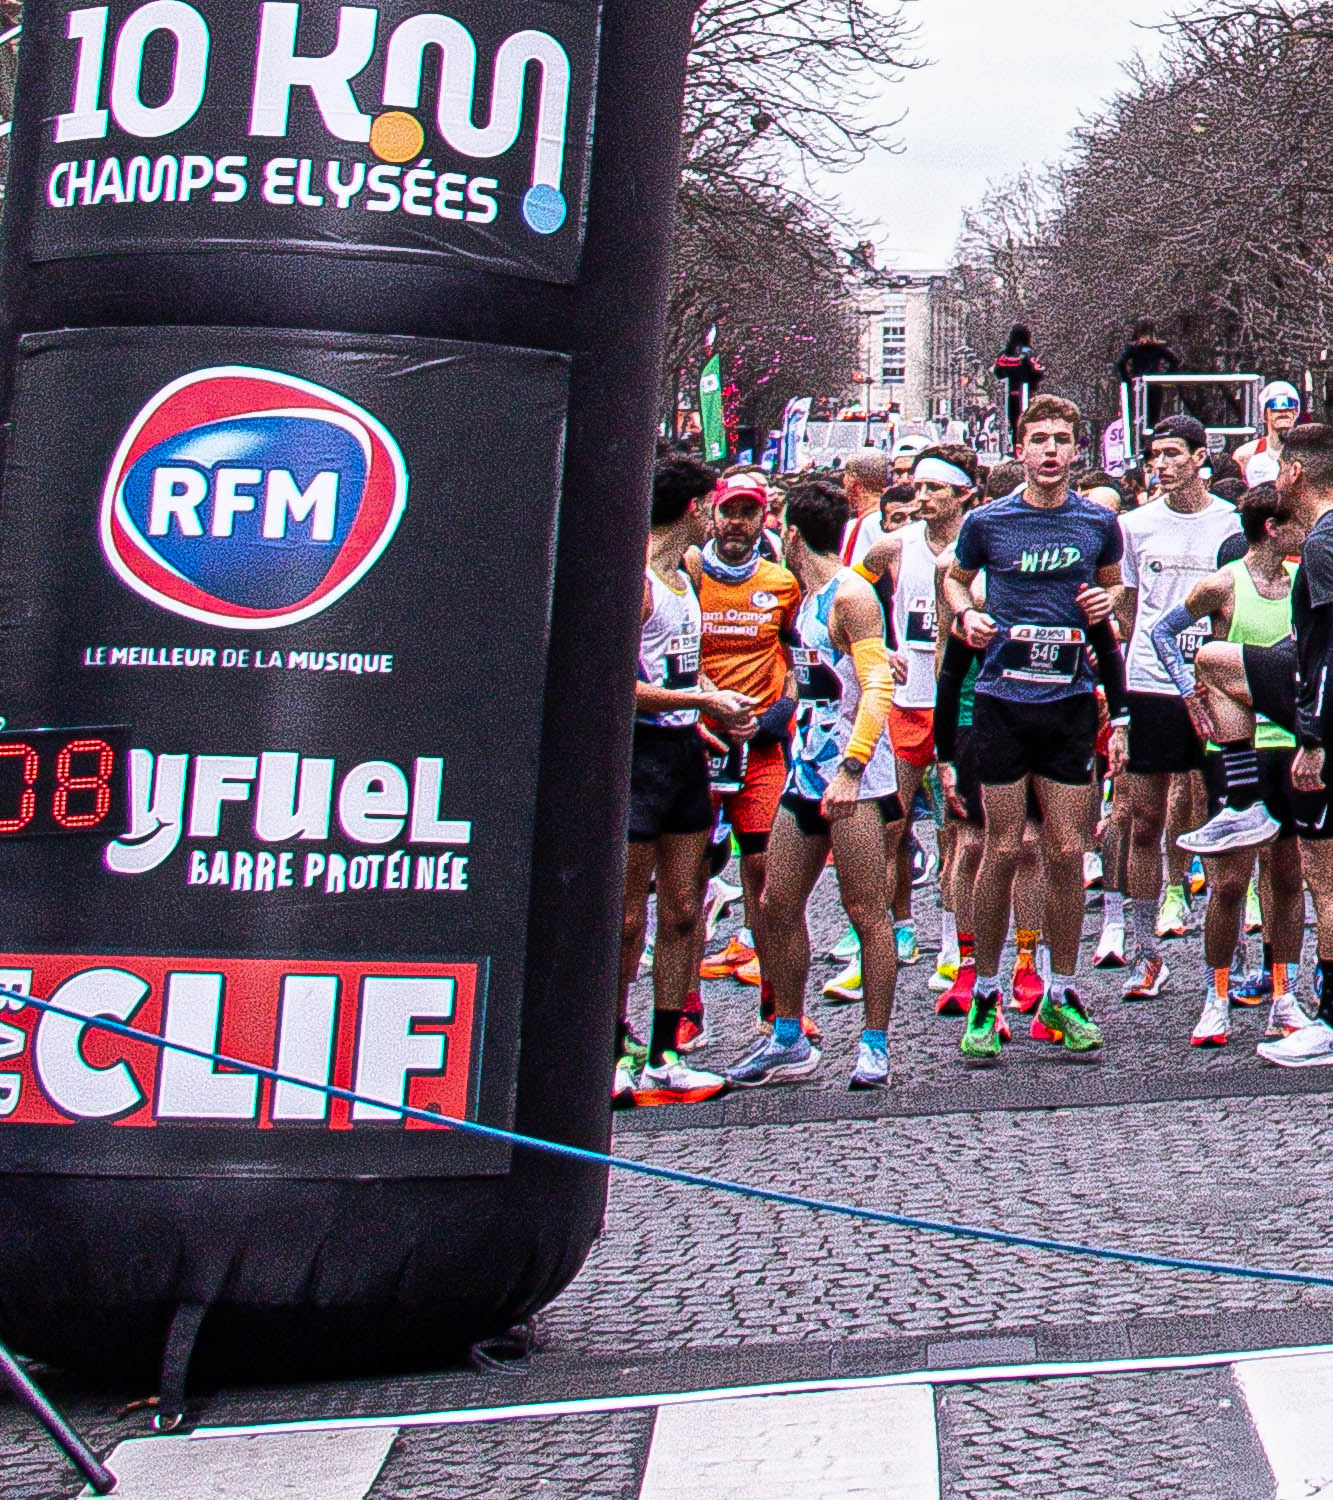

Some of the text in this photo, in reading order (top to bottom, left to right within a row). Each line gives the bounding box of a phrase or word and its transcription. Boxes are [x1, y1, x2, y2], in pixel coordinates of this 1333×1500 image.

[54, 0, 210, 143] 10
[47, 154, 499, 225] CHAMPS ELYSÉES
[148, 465, 341, 542] RFM
[1019, 547, 1081, 573] WILD
[83, 646, 394, 674] LE MEILLEUR DE LA MUSIQUE
[1029, 643, 1061, 662] 546
[187, 849, 295, 892] BARRE
[34, 967, 457, 1122] CLIF
